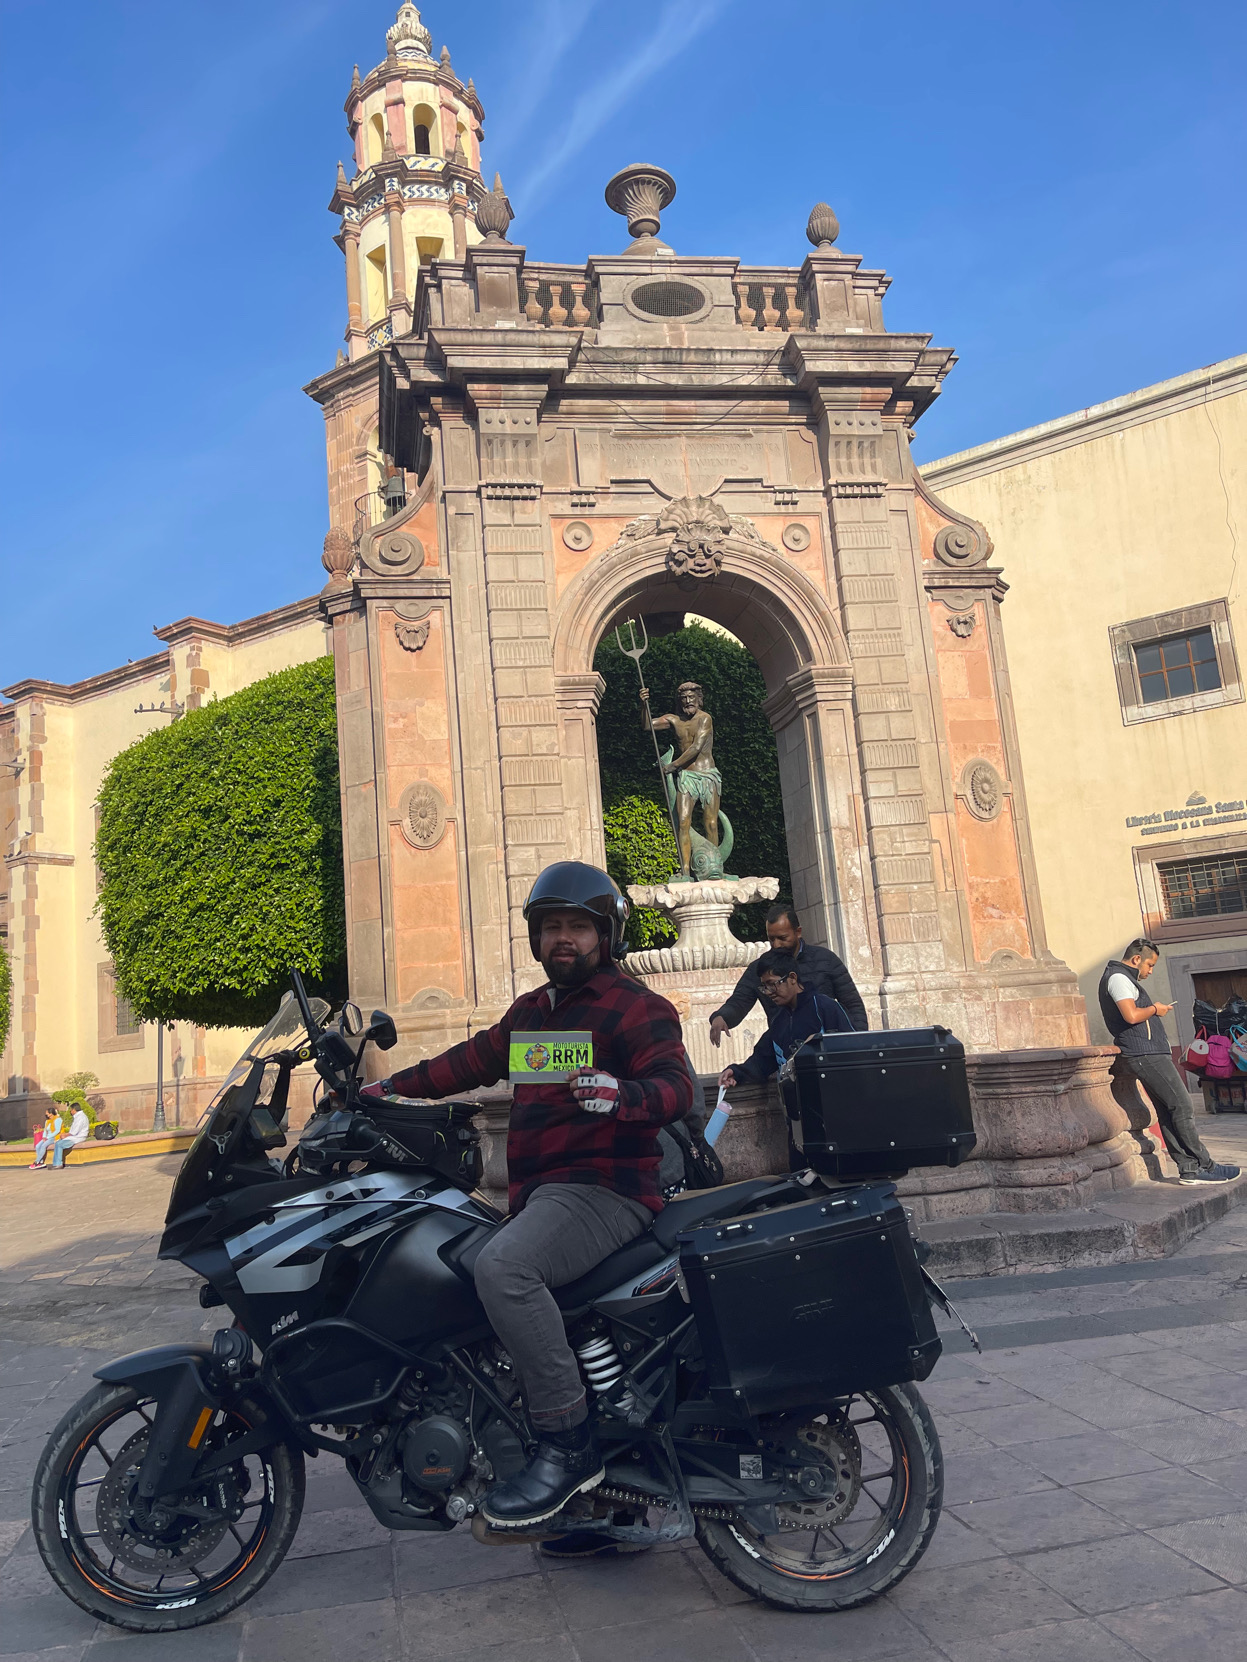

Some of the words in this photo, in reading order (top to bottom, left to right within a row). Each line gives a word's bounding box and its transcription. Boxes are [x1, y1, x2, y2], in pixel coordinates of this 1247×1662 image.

[1215, 801, 1245, 813] Santa
[1190, 819, 1201, 829] LA
[553, 1042, 589, 1050] MOTOTURISTA
[553, 1049, 589, 1064] RRM
[727, 1524, 761, 1559] KTM
[866, 1528, 896, 1565] KTM
[155, 1597, 197, 1610] KTM
